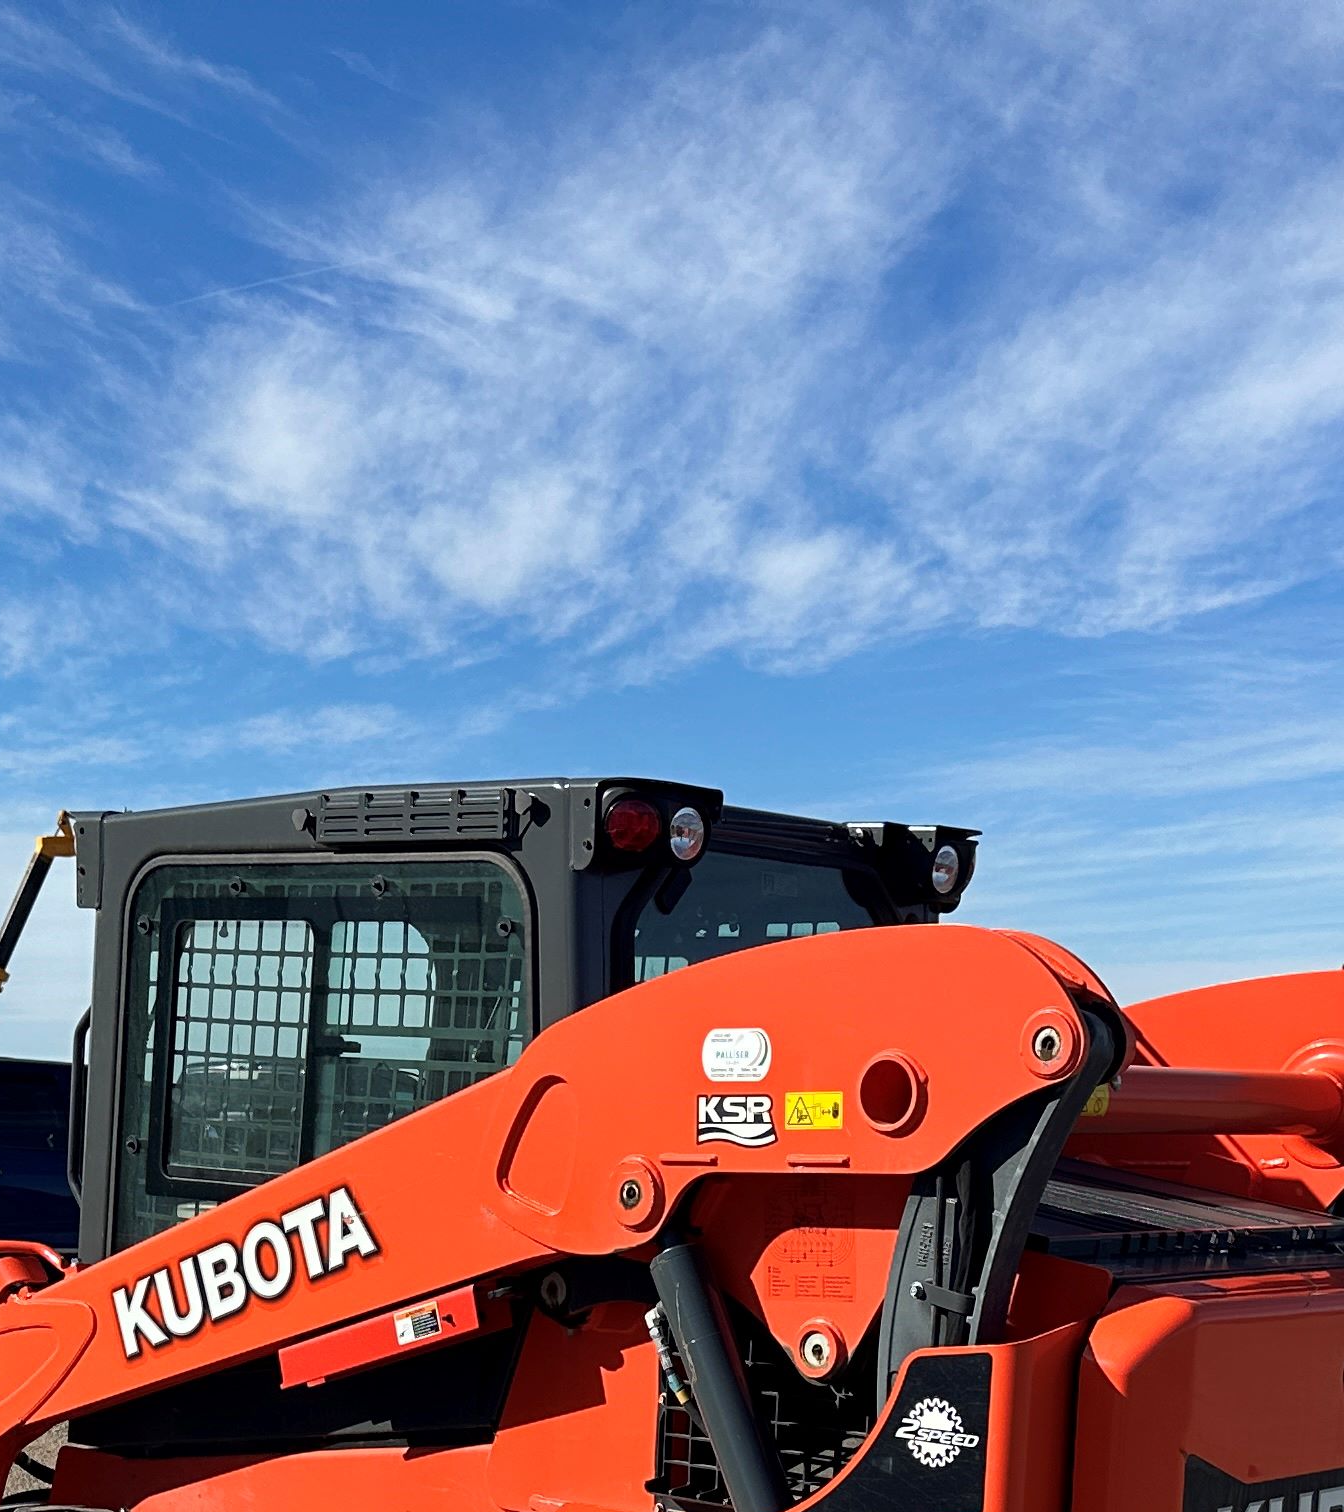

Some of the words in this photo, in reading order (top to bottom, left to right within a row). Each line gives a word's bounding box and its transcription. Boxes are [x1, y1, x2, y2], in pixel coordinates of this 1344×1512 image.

[698, 1096, 773, 1124] KSR
[112, 1187, 379, 1359] KUBOTA
[894, 1417, 921, 1440] 2
[914, 1428, 980, 1448] SPEED
